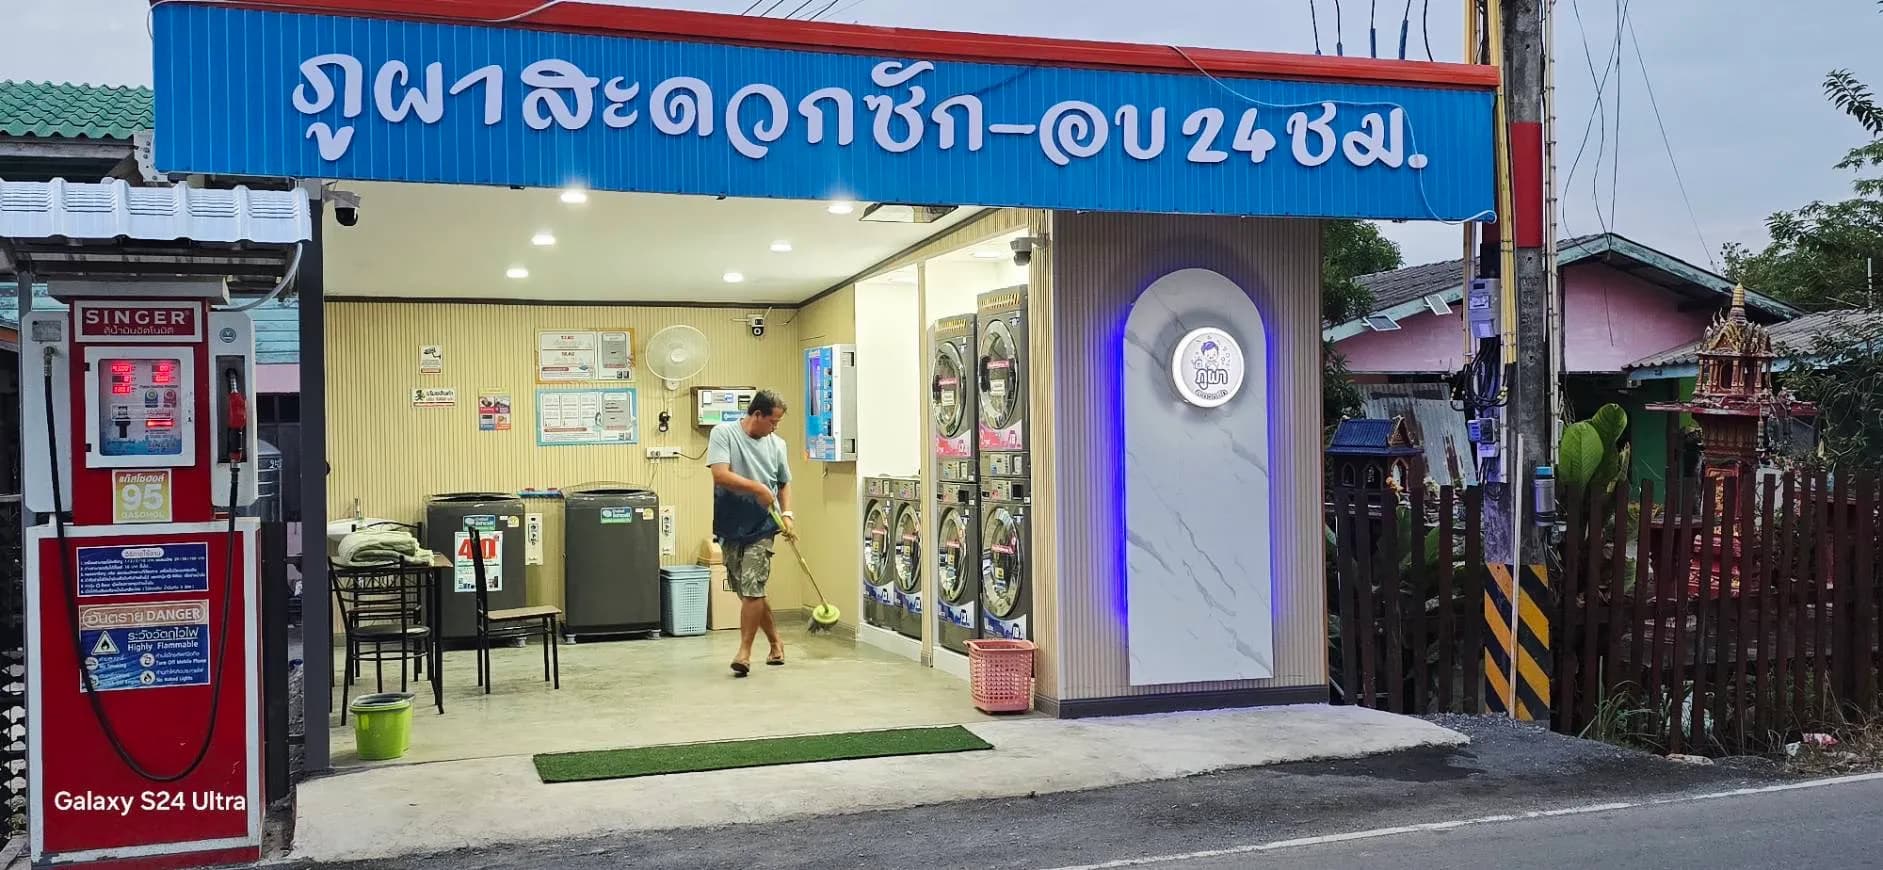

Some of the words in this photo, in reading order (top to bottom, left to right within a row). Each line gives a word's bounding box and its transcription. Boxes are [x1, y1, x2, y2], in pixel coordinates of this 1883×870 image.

[85, 310, 185, 324] SINGER
[121, 484, 163, 510] 95
[120, 511, 165, 519] GASOHOL
[87, 612, 145, 624] อันตราย
[146, 608, 201, 622] DANGER
[127, 627, 199, 641] ระวังวัตถุไวไฟ
[127, 642, 153, 652] Highly
[157, 639, 199, 650] Flammable
